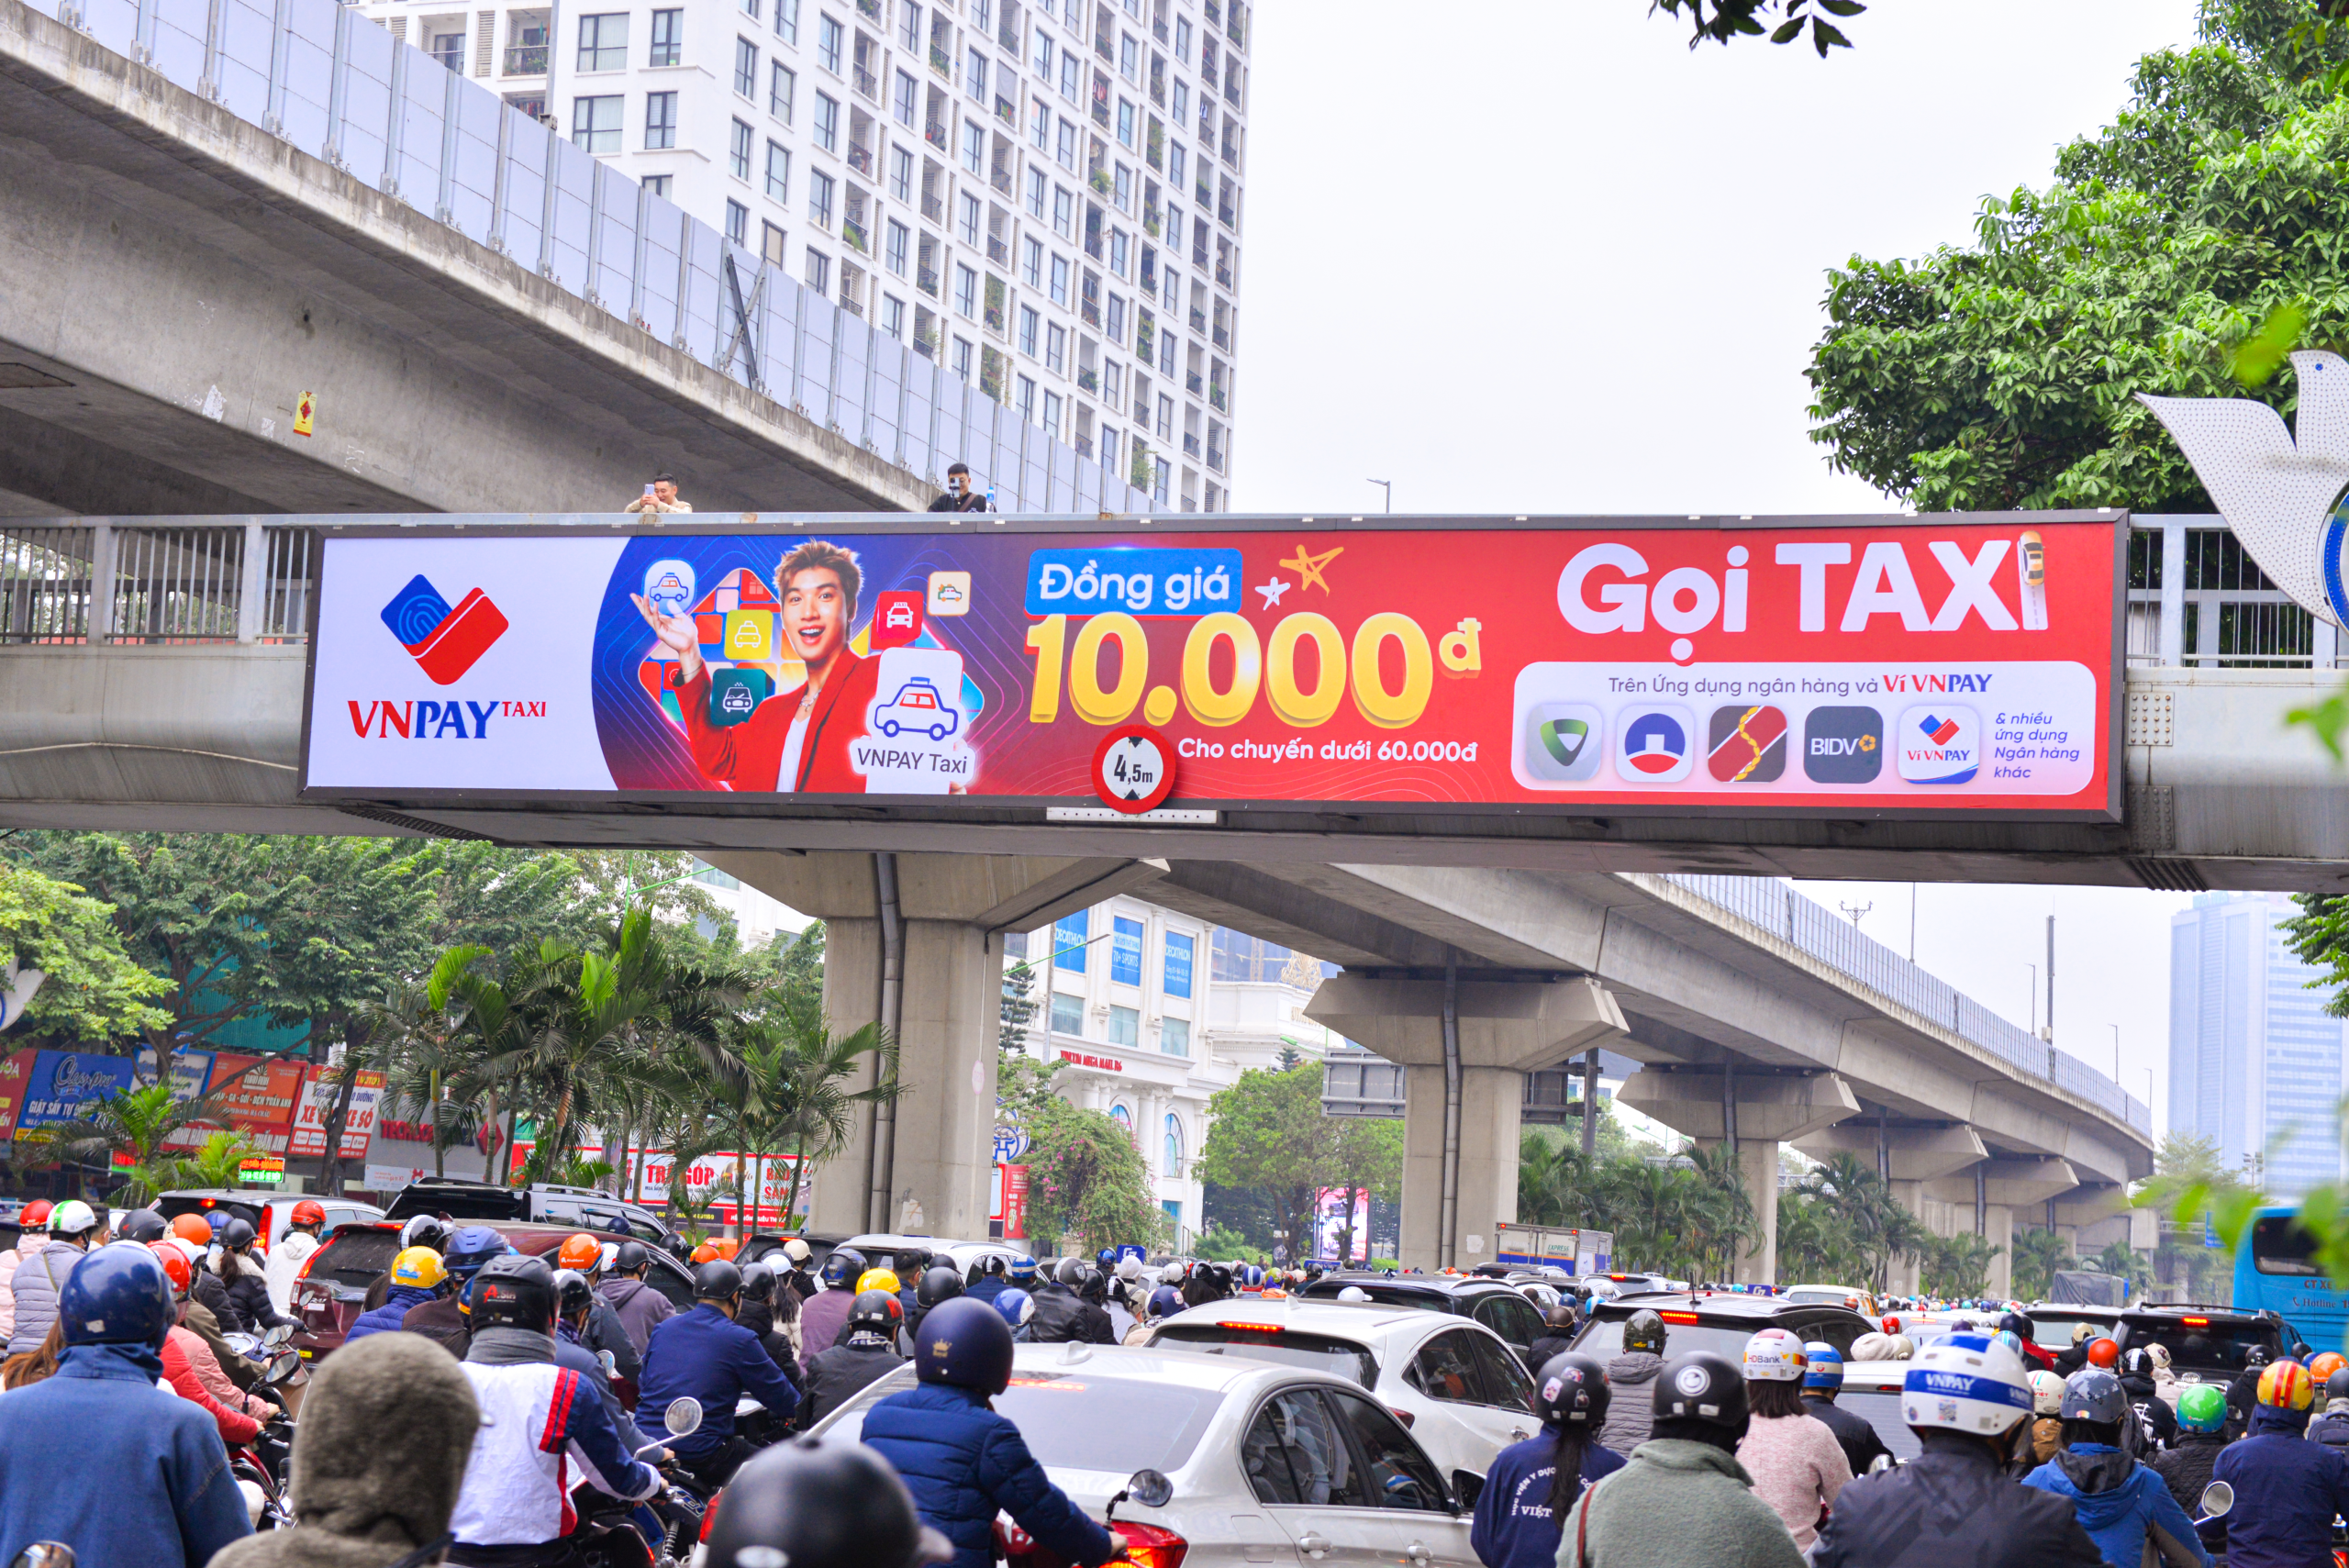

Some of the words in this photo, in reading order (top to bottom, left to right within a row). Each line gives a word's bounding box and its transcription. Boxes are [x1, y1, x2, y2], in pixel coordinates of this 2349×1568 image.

[1039, 560, 1152, 609] Đồng
[1165, 566, 1230, 610] giá
[1557, 542, 1749, 662] Gọi
[1776, 532, 2048, 632] TAXI
[1026, 612, 1482, 728] 10.000đ
[1609, 677, 1646, 693] Trên
[1653, 673, 1688, 696] Ứng
[1694, 678, 1742, 696] dụng
[1748, 678, 1796, 697] ngân
[1801, 678, 1849, 697] hàng
[1855, 678, 1878, 693] và
[1882, 674, 1907, 693] Ví
[1911, 674, 1993, 693] VNPAY
[347, 700, 500, 740] VNPAY
[502, 700, 547, 718] TAXI
[1996, 713, 2006, 725] &
[1995, 728, 2023, 743] ứng
[2028, 728, 2067, 744] dụng
[1177, 738, 1224, 759] Cho
[1230, 738, 1315, 764] chuyến
[1320, 739, 1371, 761] dưới
[1376, 740, 1478, 762] 60.000đ
[1810, 738, 1860, 756] BIDV
[1995, 747, 2035, 762] Ngân
[2040, 747, 2080, 762] hàng
[857, 748, 925, 771] VNPAY
[929, 751, 968, 775] Taxi
[1908, 750, 1921, 762] Ví
[1924, 750, 1971, 762] VNPAY
[1994, 766, 2032, 779] khác
[1055, 928, 1085, 949] DECATHLON
[1122, 952, 1139, 968] SPORTS
[1165, 944, 1191, 962] DECATHLON
[1083, 1055, 1098, 1068] MEGA
[301, 1105, 317, 1124] XE
[1548, 1244, 1569, 1252] EXPRESS
[2304, 1280, 2317, 1289] CT
[2303, 1298, 2336, 1308] Hotline
[1749, 1355, 1780, 1363] HDBank
[1926, 1373, 1975, 1392] VNPAY
[1520, 1505, 1553, 1518] VIỆT
